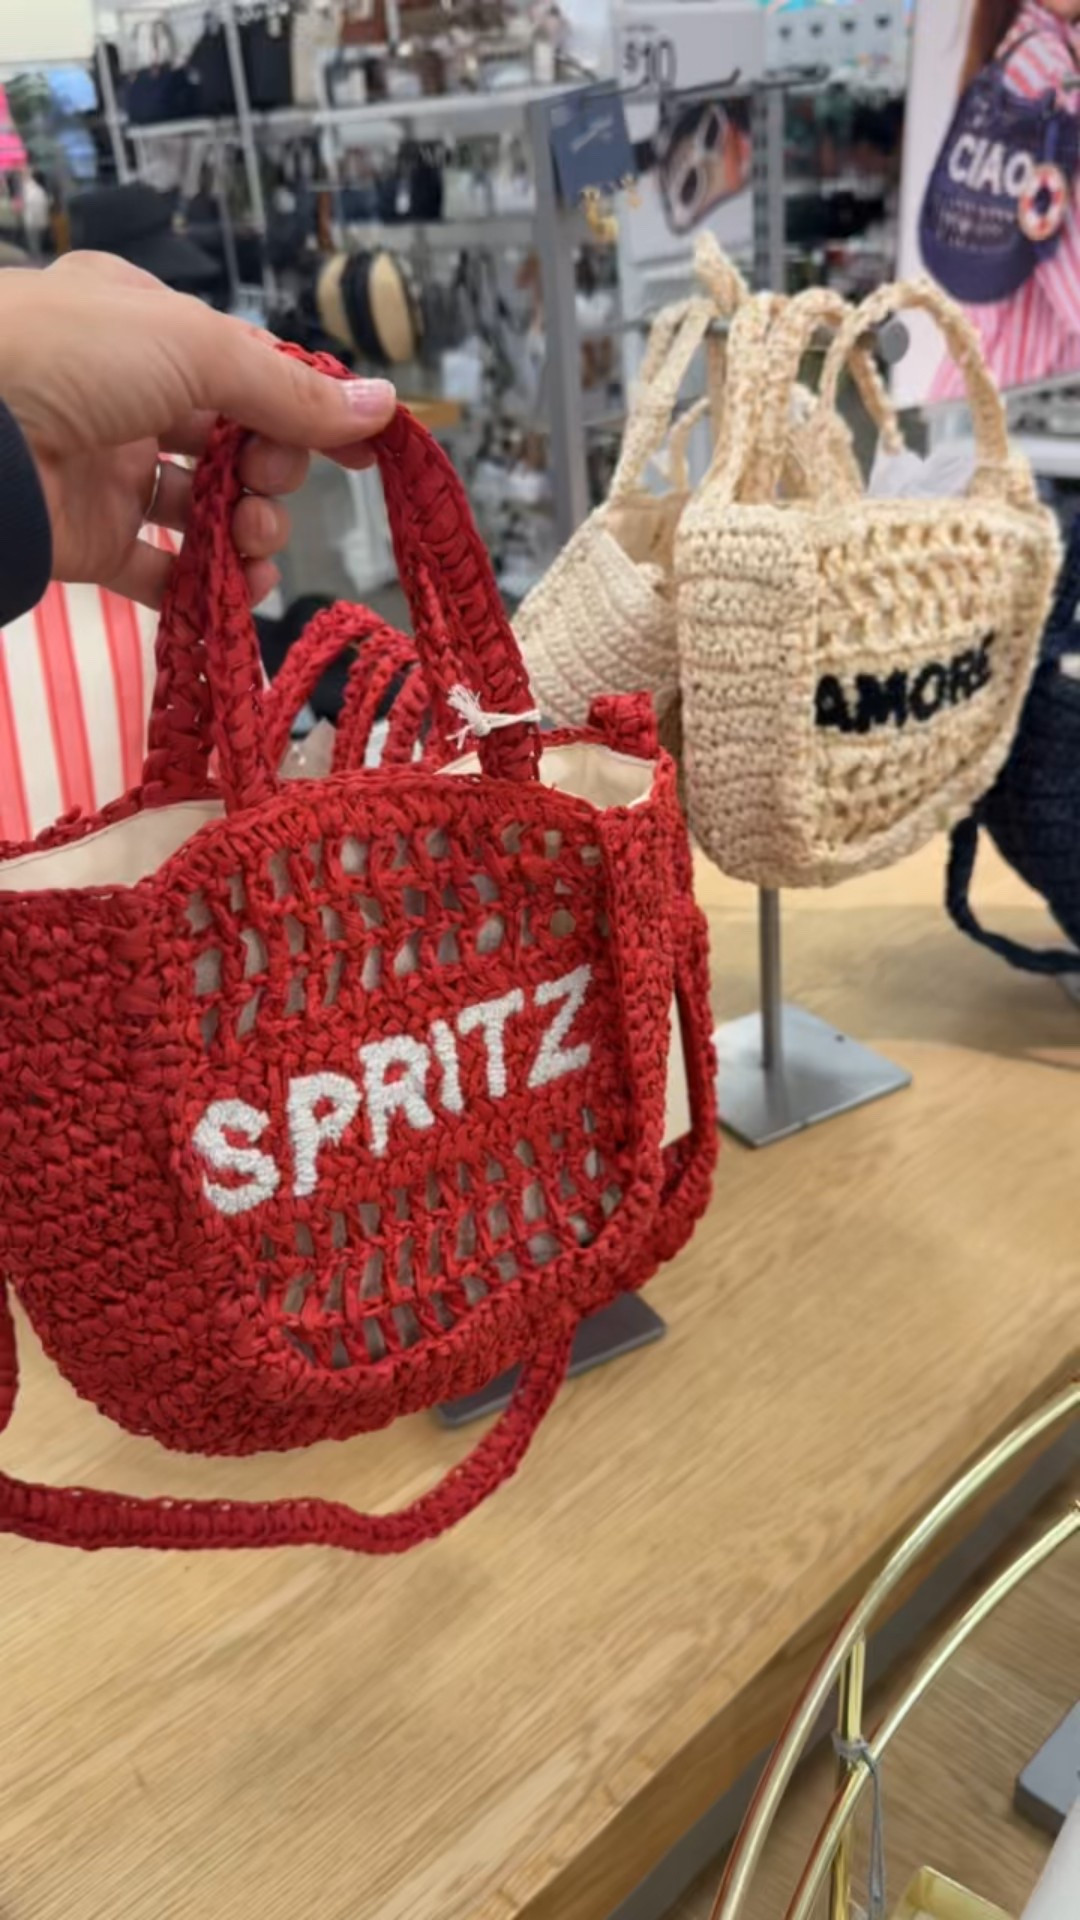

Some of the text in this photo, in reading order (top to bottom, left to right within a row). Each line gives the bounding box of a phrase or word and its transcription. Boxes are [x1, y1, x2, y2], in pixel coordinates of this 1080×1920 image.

[947, 132, 1035, 198] CIAO
[814, 629, 993, 734] AMORE
[192, 964, 592, 1215] SPRITZ
